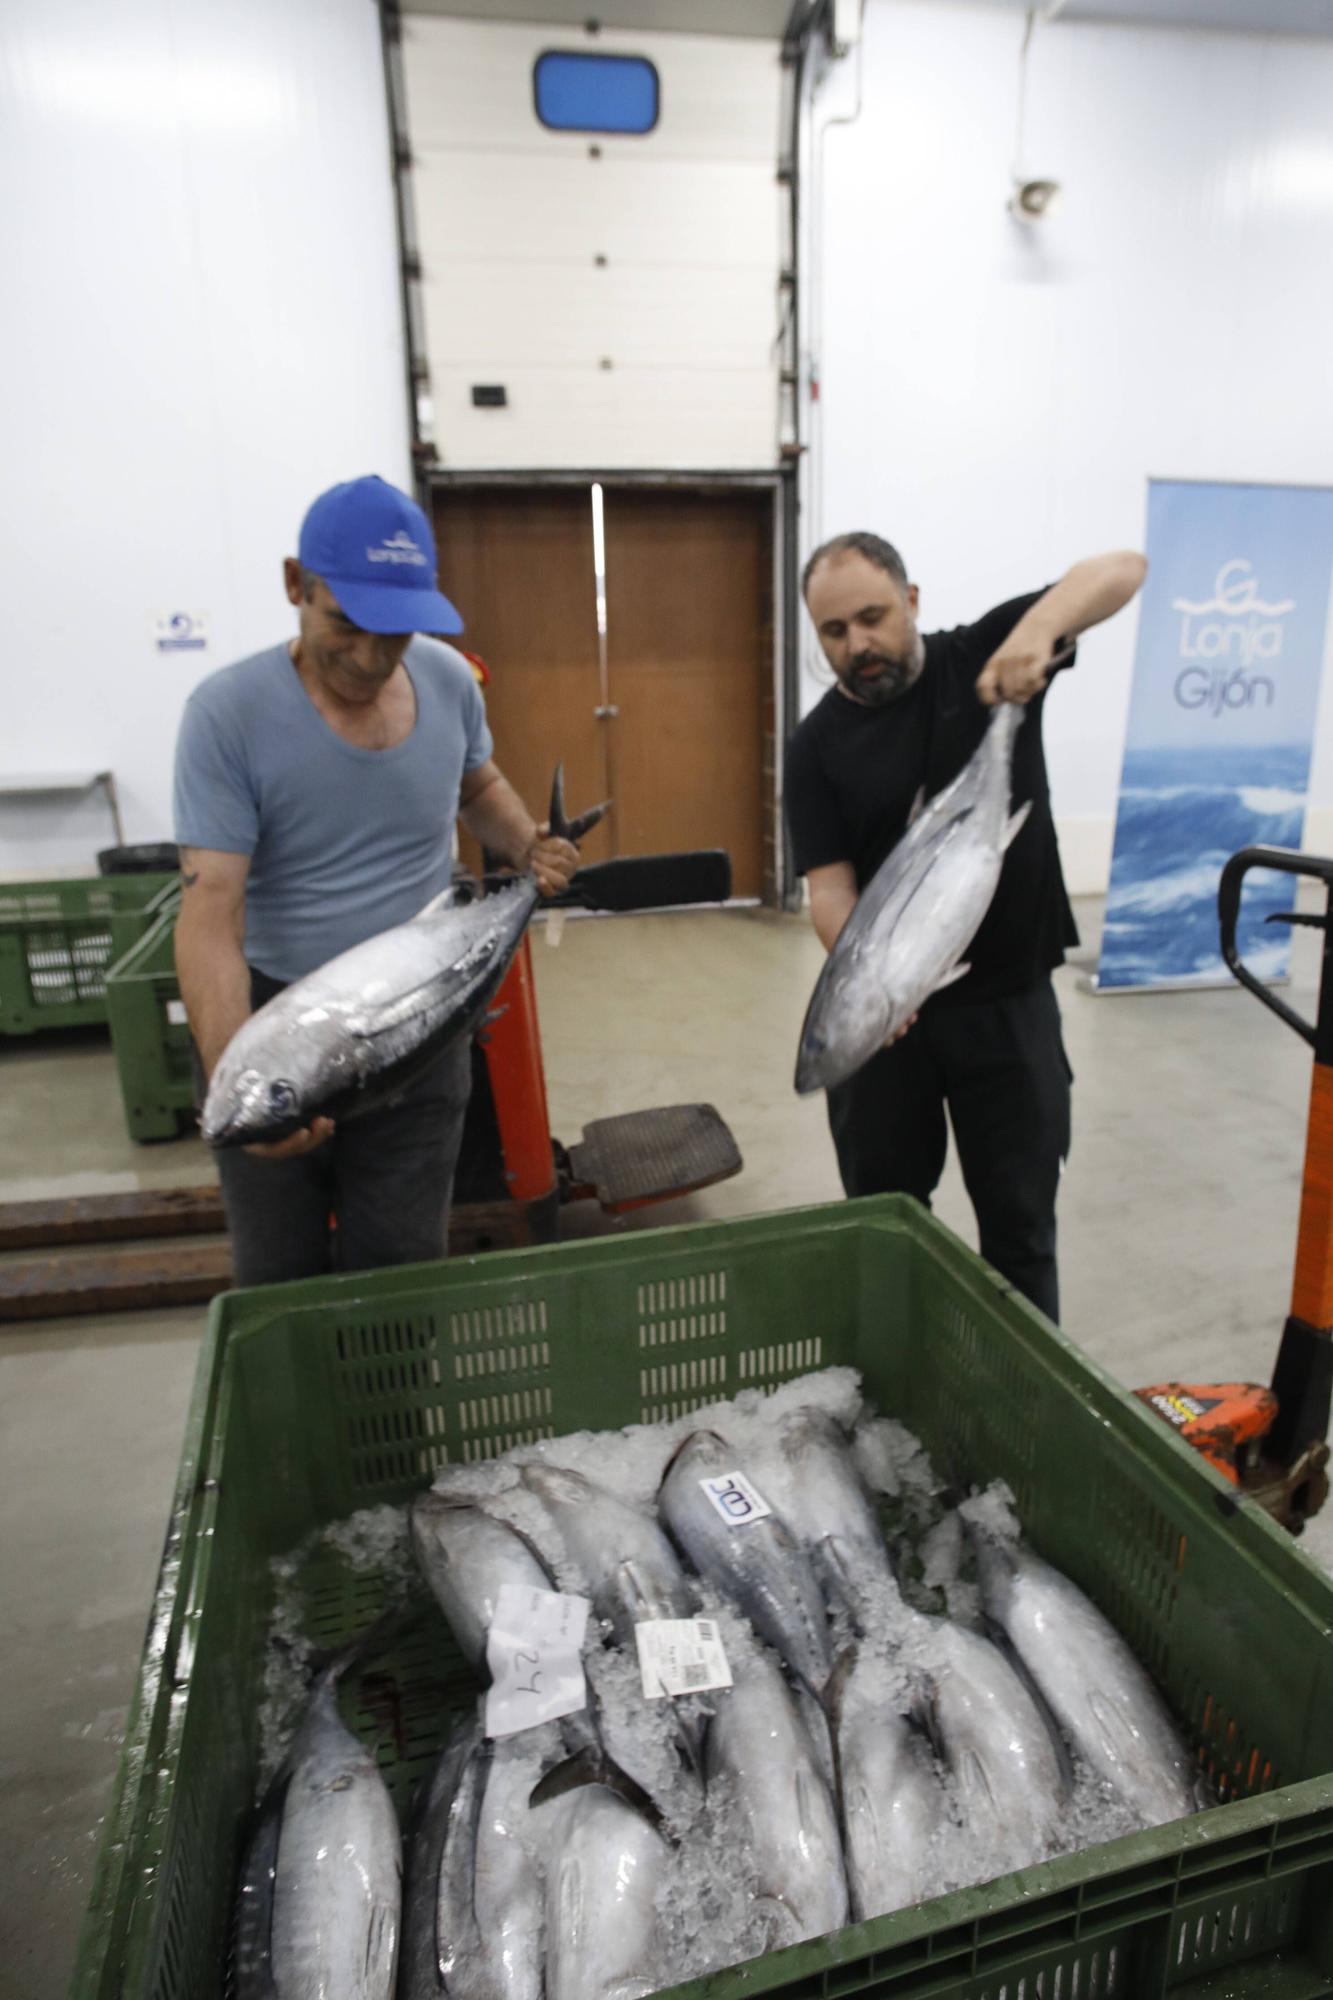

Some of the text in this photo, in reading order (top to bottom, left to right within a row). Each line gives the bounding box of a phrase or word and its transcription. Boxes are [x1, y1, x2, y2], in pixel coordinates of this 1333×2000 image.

[1179, 614, 1284, 665] Lonja
[1173, 665, 1276, 719] Gijón
[513, 1651, 543, 1695] 24
